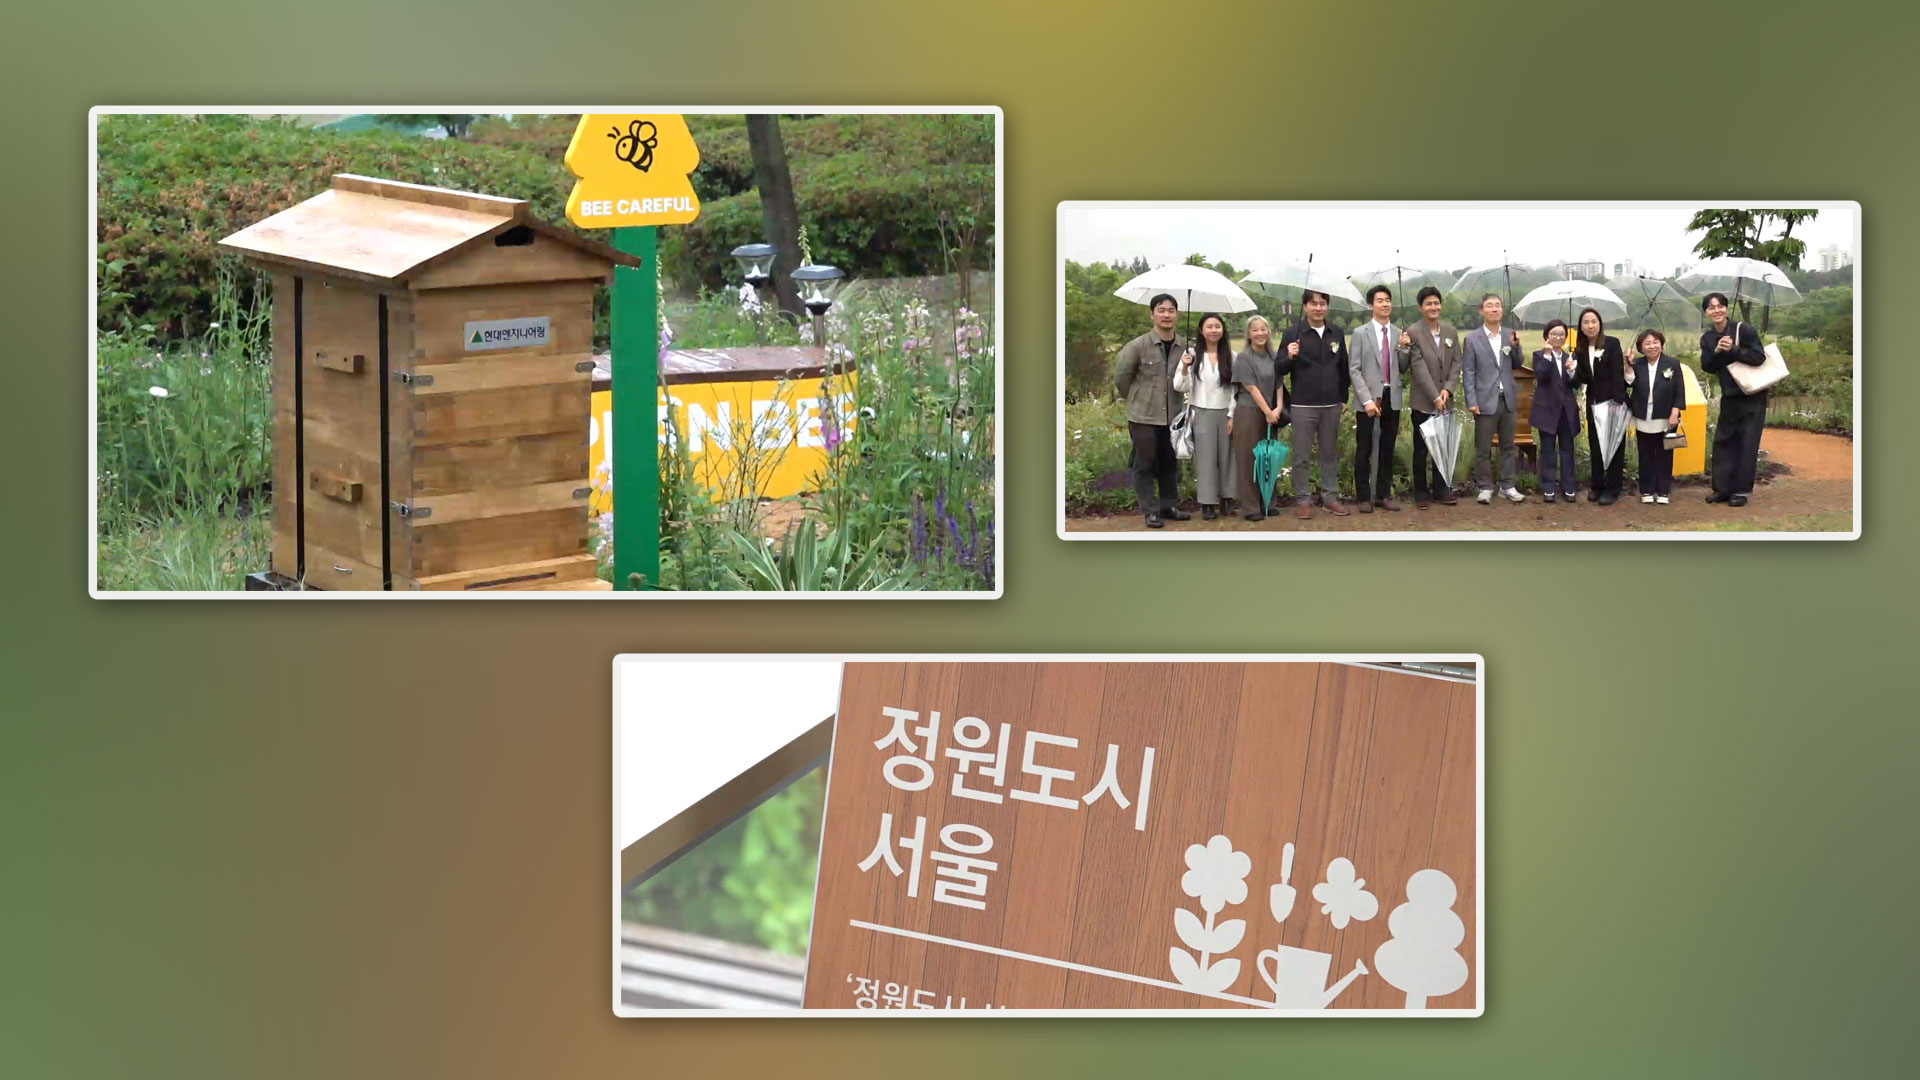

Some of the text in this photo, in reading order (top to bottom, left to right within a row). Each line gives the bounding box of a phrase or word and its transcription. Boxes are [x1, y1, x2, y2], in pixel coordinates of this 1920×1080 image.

[580, 196, 695, 216] BEE CAREFUL
[484, 326, 546, 343] 현대엔지니어링
[873, 705, 1156, 832] 정원도시
[856, 812, 999, 911] 서울
